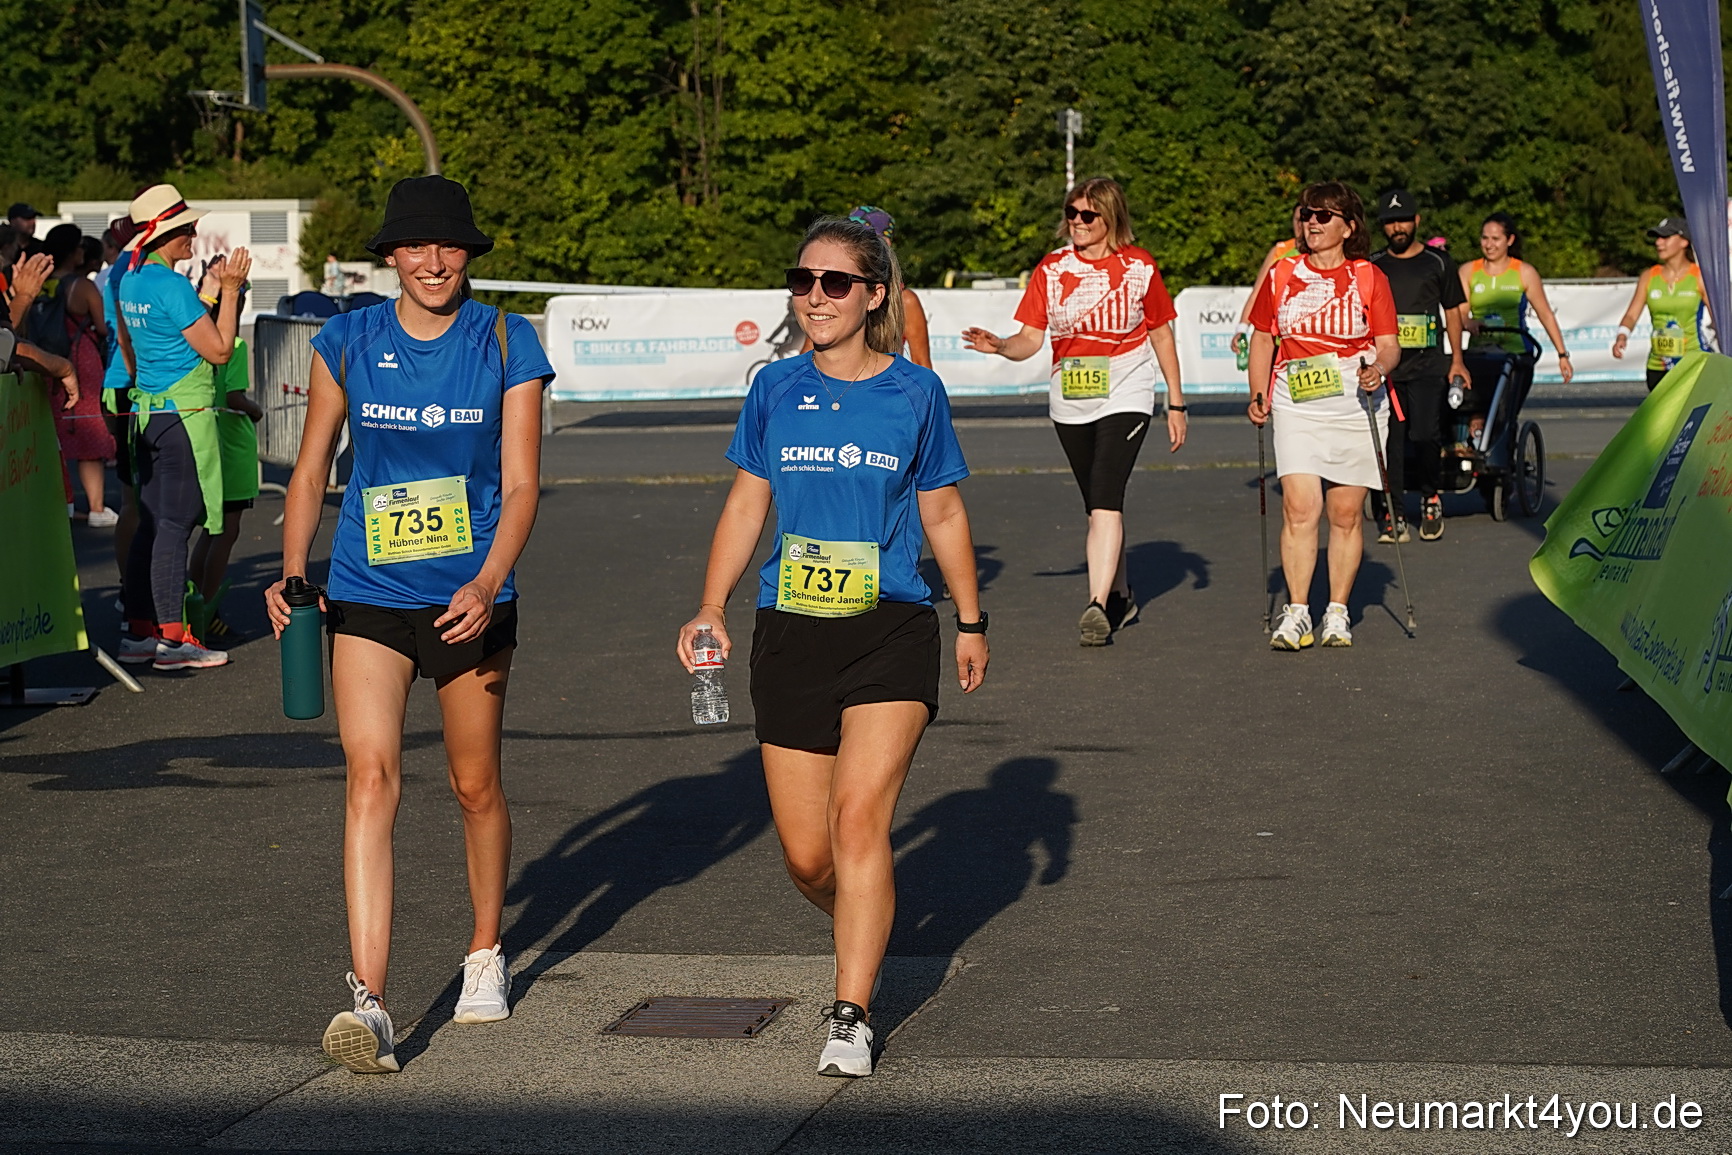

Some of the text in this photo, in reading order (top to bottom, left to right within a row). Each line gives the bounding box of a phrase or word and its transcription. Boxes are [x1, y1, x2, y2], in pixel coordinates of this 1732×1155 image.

[572, 317, 610, 331] NOW
[1200, 311, 1236, 324] NOW
[634, 341, 645, 353] &
[649, 337, 737, 352] FAHRRÄDER
[1068, 371, 1101, 384] 1115
[1296, 368, 1331, 388] 1121
[361, 402, 480, 422] SCHICK BAU
[361, 421, 379, 429] einfach
[379, 422, 398, 430] schick
[780, 446, 896, 469] SCHICK BAU
[816, 465, 834, 473] bauen
[389, 506, 444, 537] 735
[454, 507, 466, 543] 2022
[371, 517, 382, 555] WALK
[389, 534, 449, 548] Hübner Nina
[784, 564, 792, 601] WALK
[801, 565, 852, 593] 737
[791, 590, 864, 604] Schneider Janet
[864, 574, 874, 605] 2022
